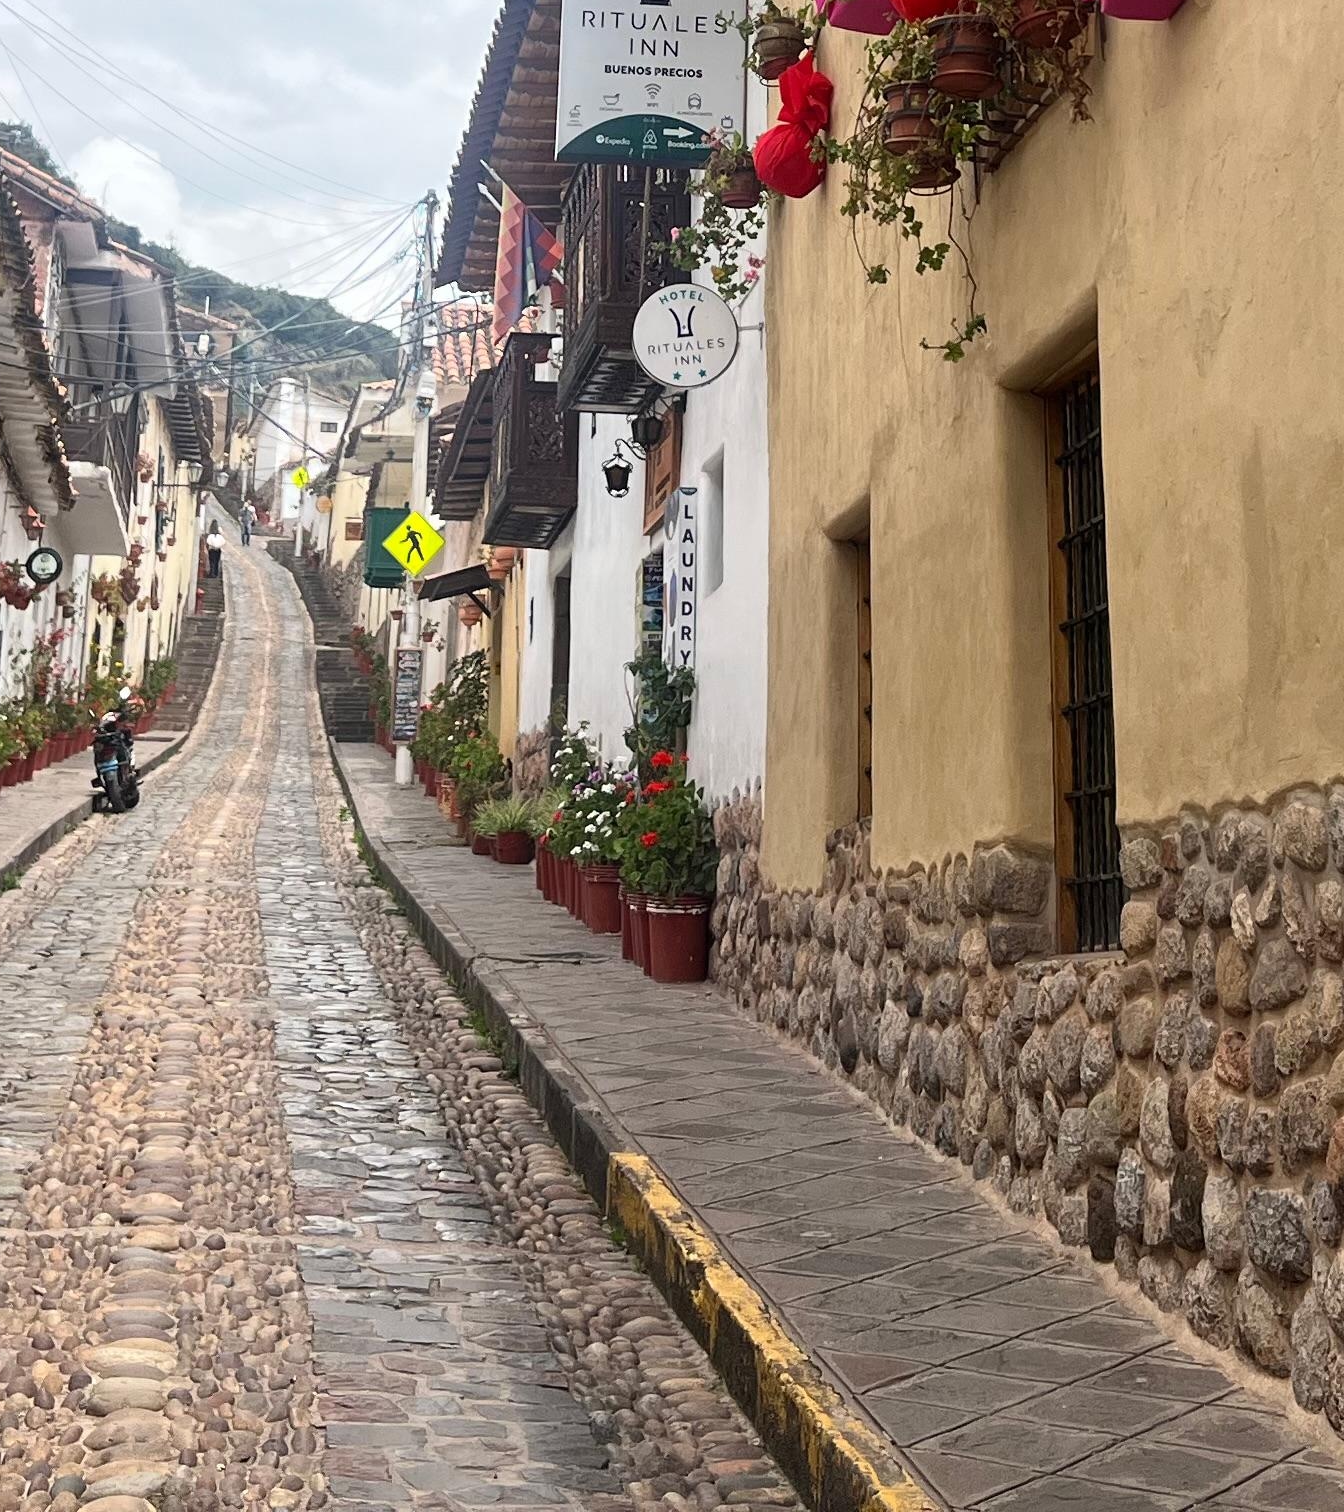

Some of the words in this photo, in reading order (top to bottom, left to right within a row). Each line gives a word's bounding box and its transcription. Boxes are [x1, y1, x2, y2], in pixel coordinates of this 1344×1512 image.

[582, 10, 728, 34] RITUALES
[630, 38, 679, 57] INN
[605, 65, 651, 76] BUENOS
[655, 67, 702, 78] PRECIOS
[659, 290, 704, 304] HOTEL
[648, 338, 725, 355] RITUALES
[674, 355, 702, 365] INN
[681, 504, 694, 665] LAUNDRY
